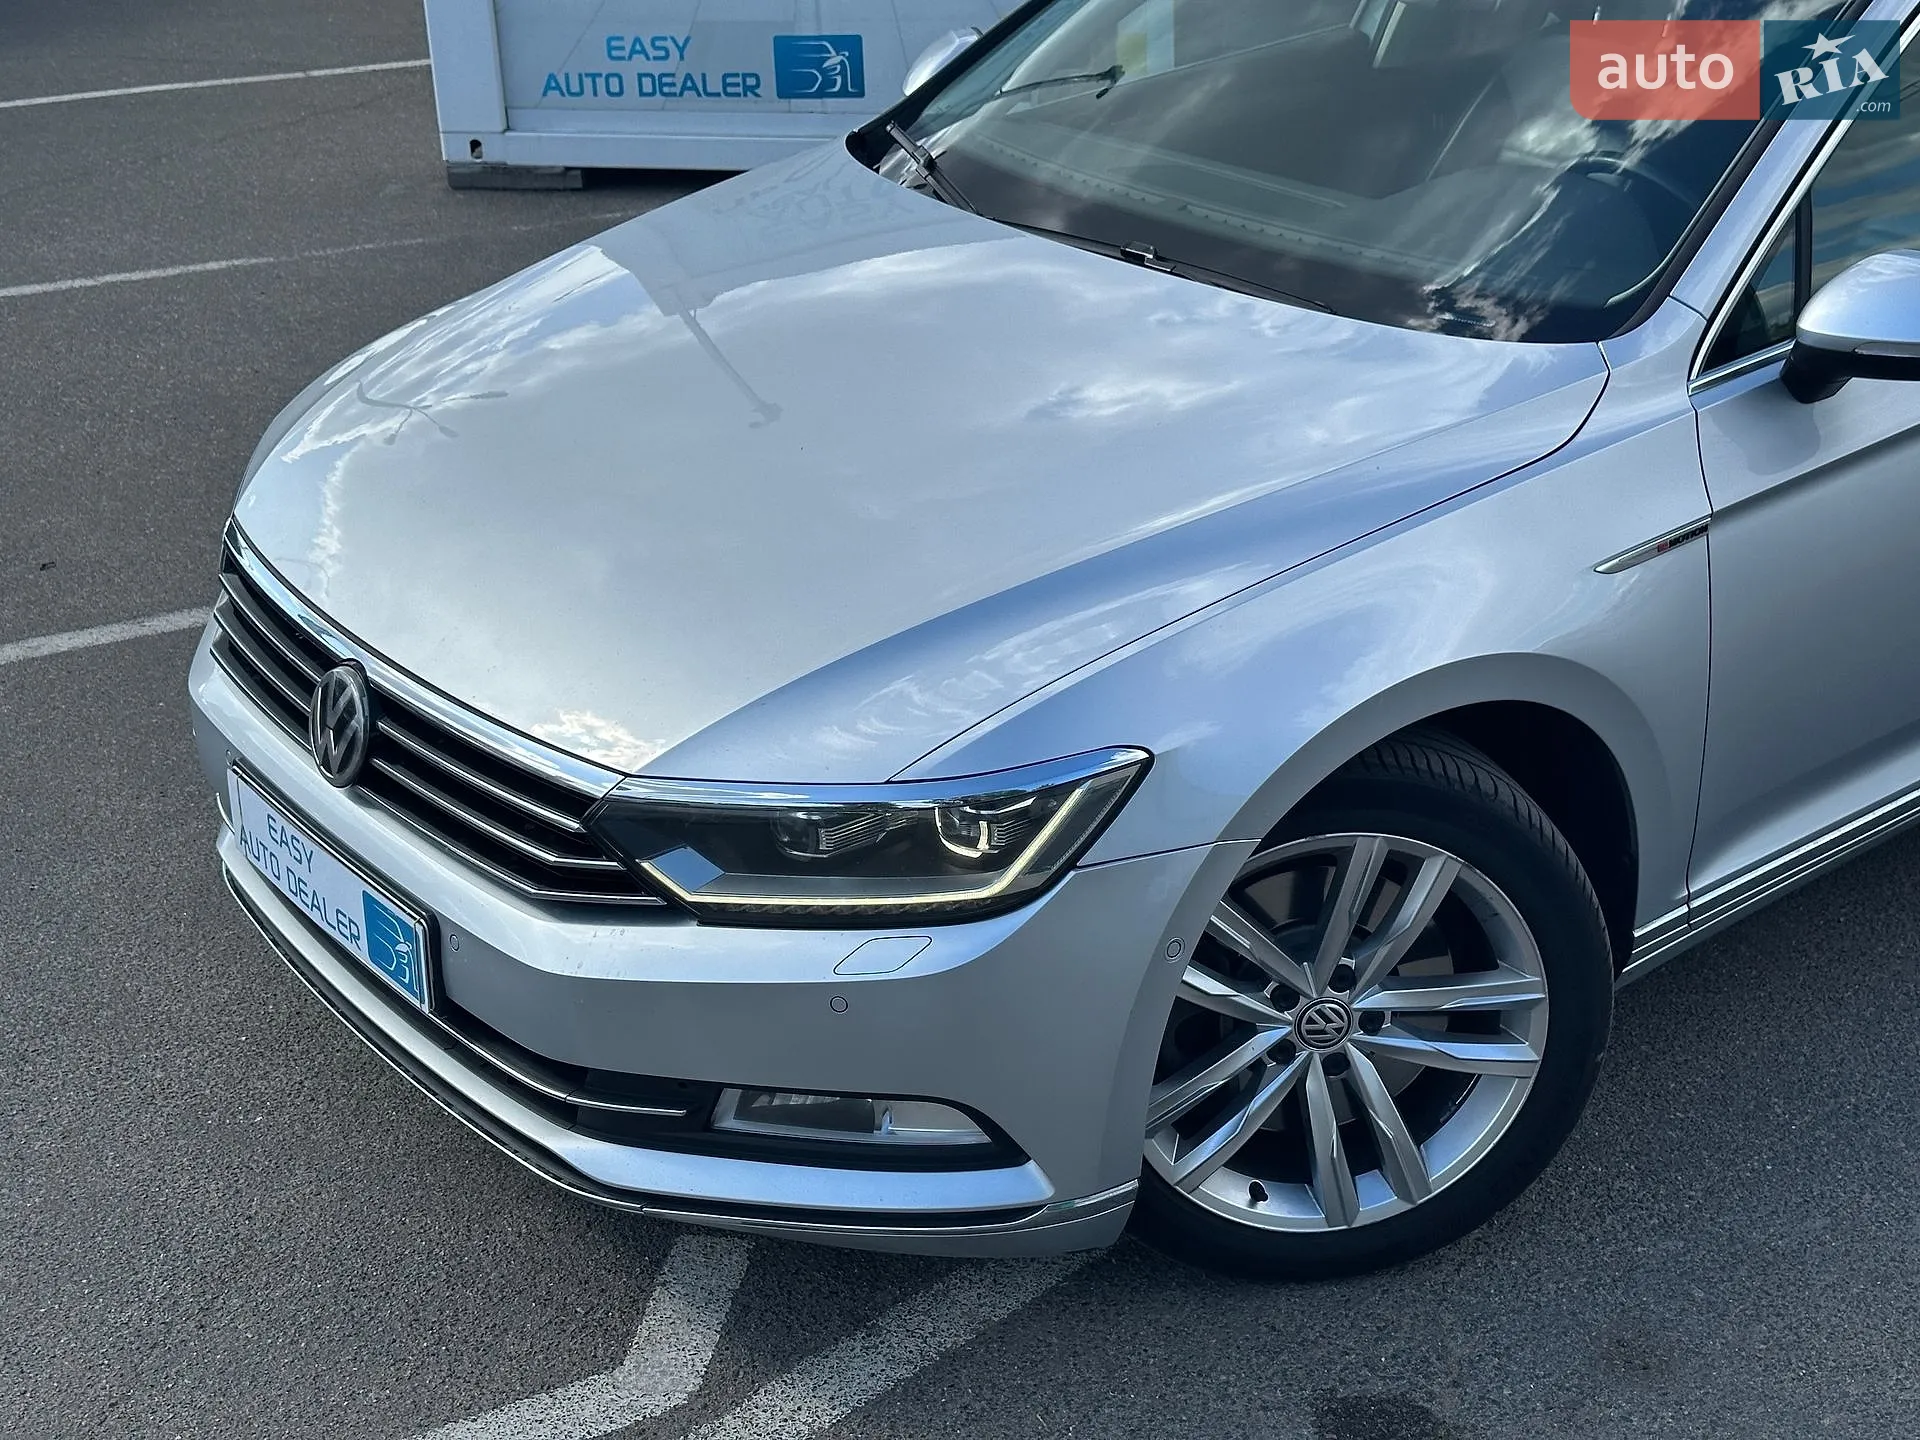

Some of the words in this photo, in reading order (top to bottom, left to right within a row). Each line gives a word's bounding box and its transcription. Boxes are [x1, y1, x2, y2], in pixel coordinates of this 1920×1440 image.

[606, 36, 691, 62] EASY
[543, 72, 624, 97] AUTO
[637, 72, 762, 97] DEALER
[266, 813, 314, 873] EASY
[239, 825, 281, 881] AUTO
[286, 866, 362, 952] DEALER
